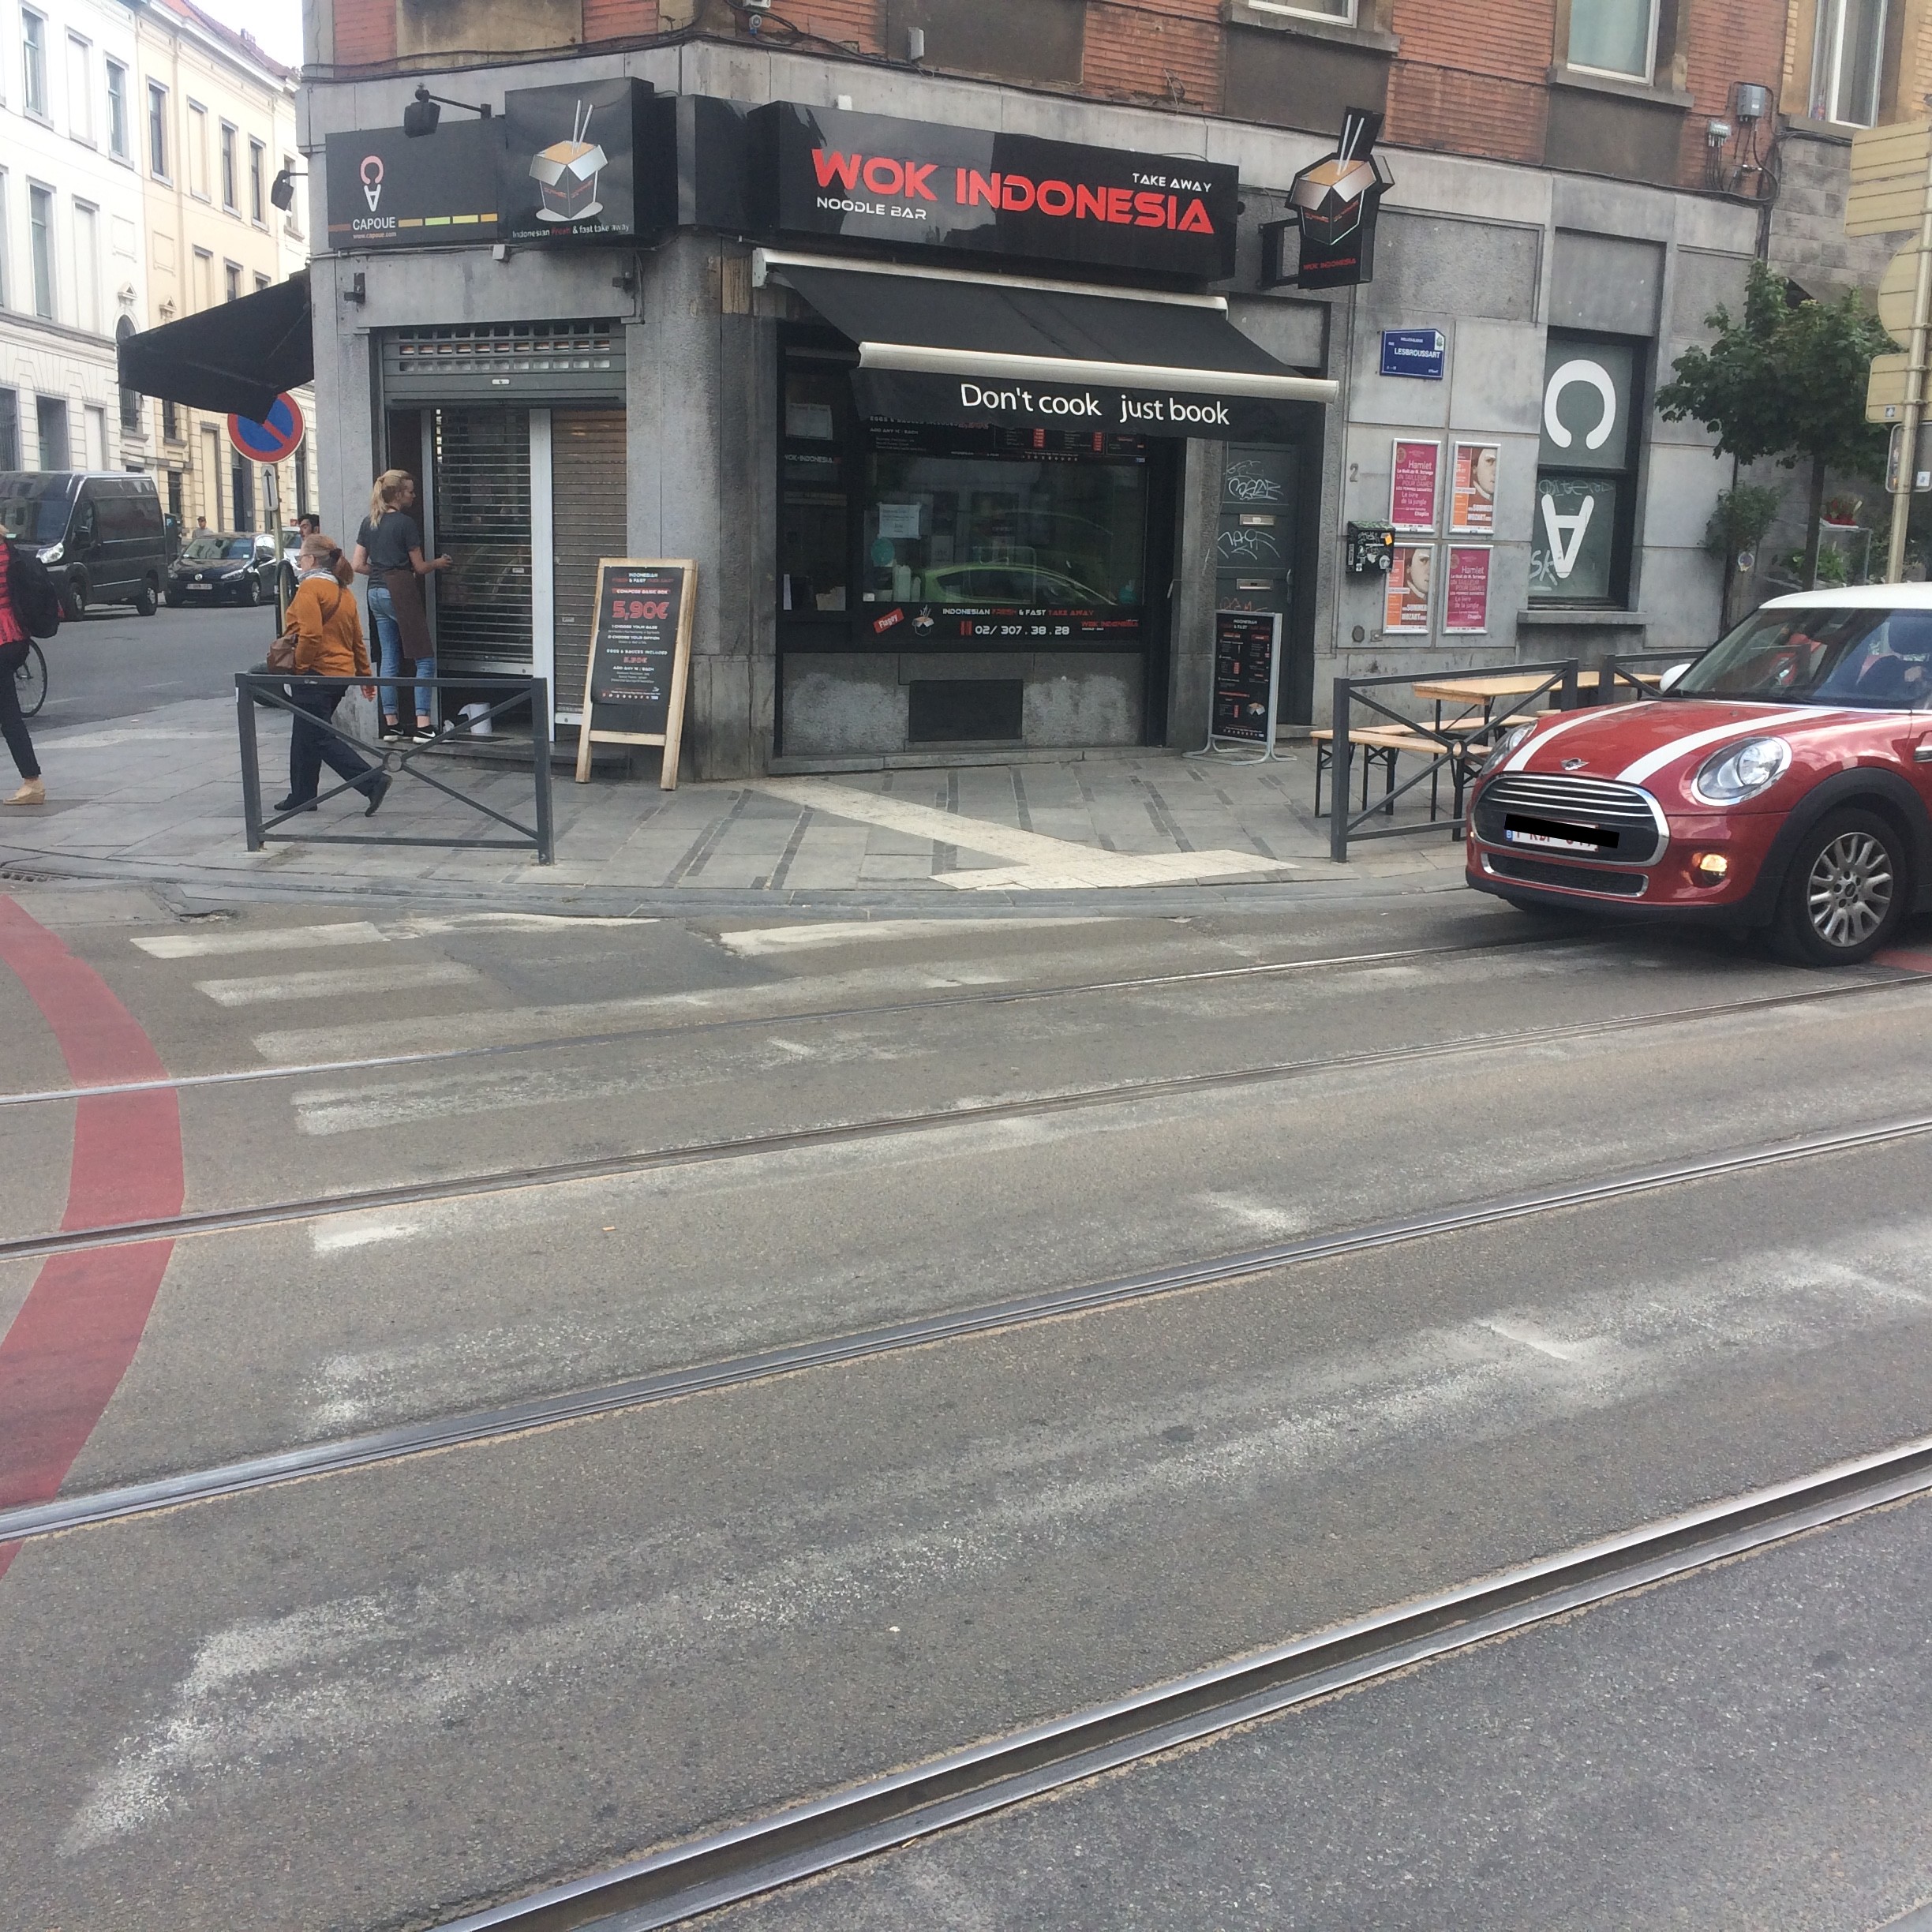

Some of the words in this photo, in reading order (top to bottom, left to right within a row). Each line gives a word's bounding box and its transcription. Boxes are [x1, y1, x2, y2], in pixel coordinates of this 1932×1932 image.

[1132, 172, 1166, 187] TAKE
[1170, 178, 1212, 193] AWAY
[811, 148, 939, 201] WOK
[956, 167, 1215, 234] INDONESIA
[817, 197, 886, 215] NOODLE
[890, 206, 927, 220] BAR
[352, 216, 396, 230] CAPOUE
[512, 229, 550, 238] Indonesian
[579, 225, 593, 234] fast
[593, 224, 610, 233] take
[611, 224, 630, 234] away
[1394, 347, 1441, 359] LESBROUSSART
[960, 383, 1035, 413] Don't
[1039, 392, 1103, 416] cook
[1119, 394, 1164, 423] just
[1169, 397, 1230, 425] book
[1408, 459, 1432, 470] Hamlet
[1461, 565, 1485, 575] Hamlet
[612, 601, 670, 621] 5,90€
[975, 625, 998, 635] 02/
[1000, 625, 1023, 635] 307
